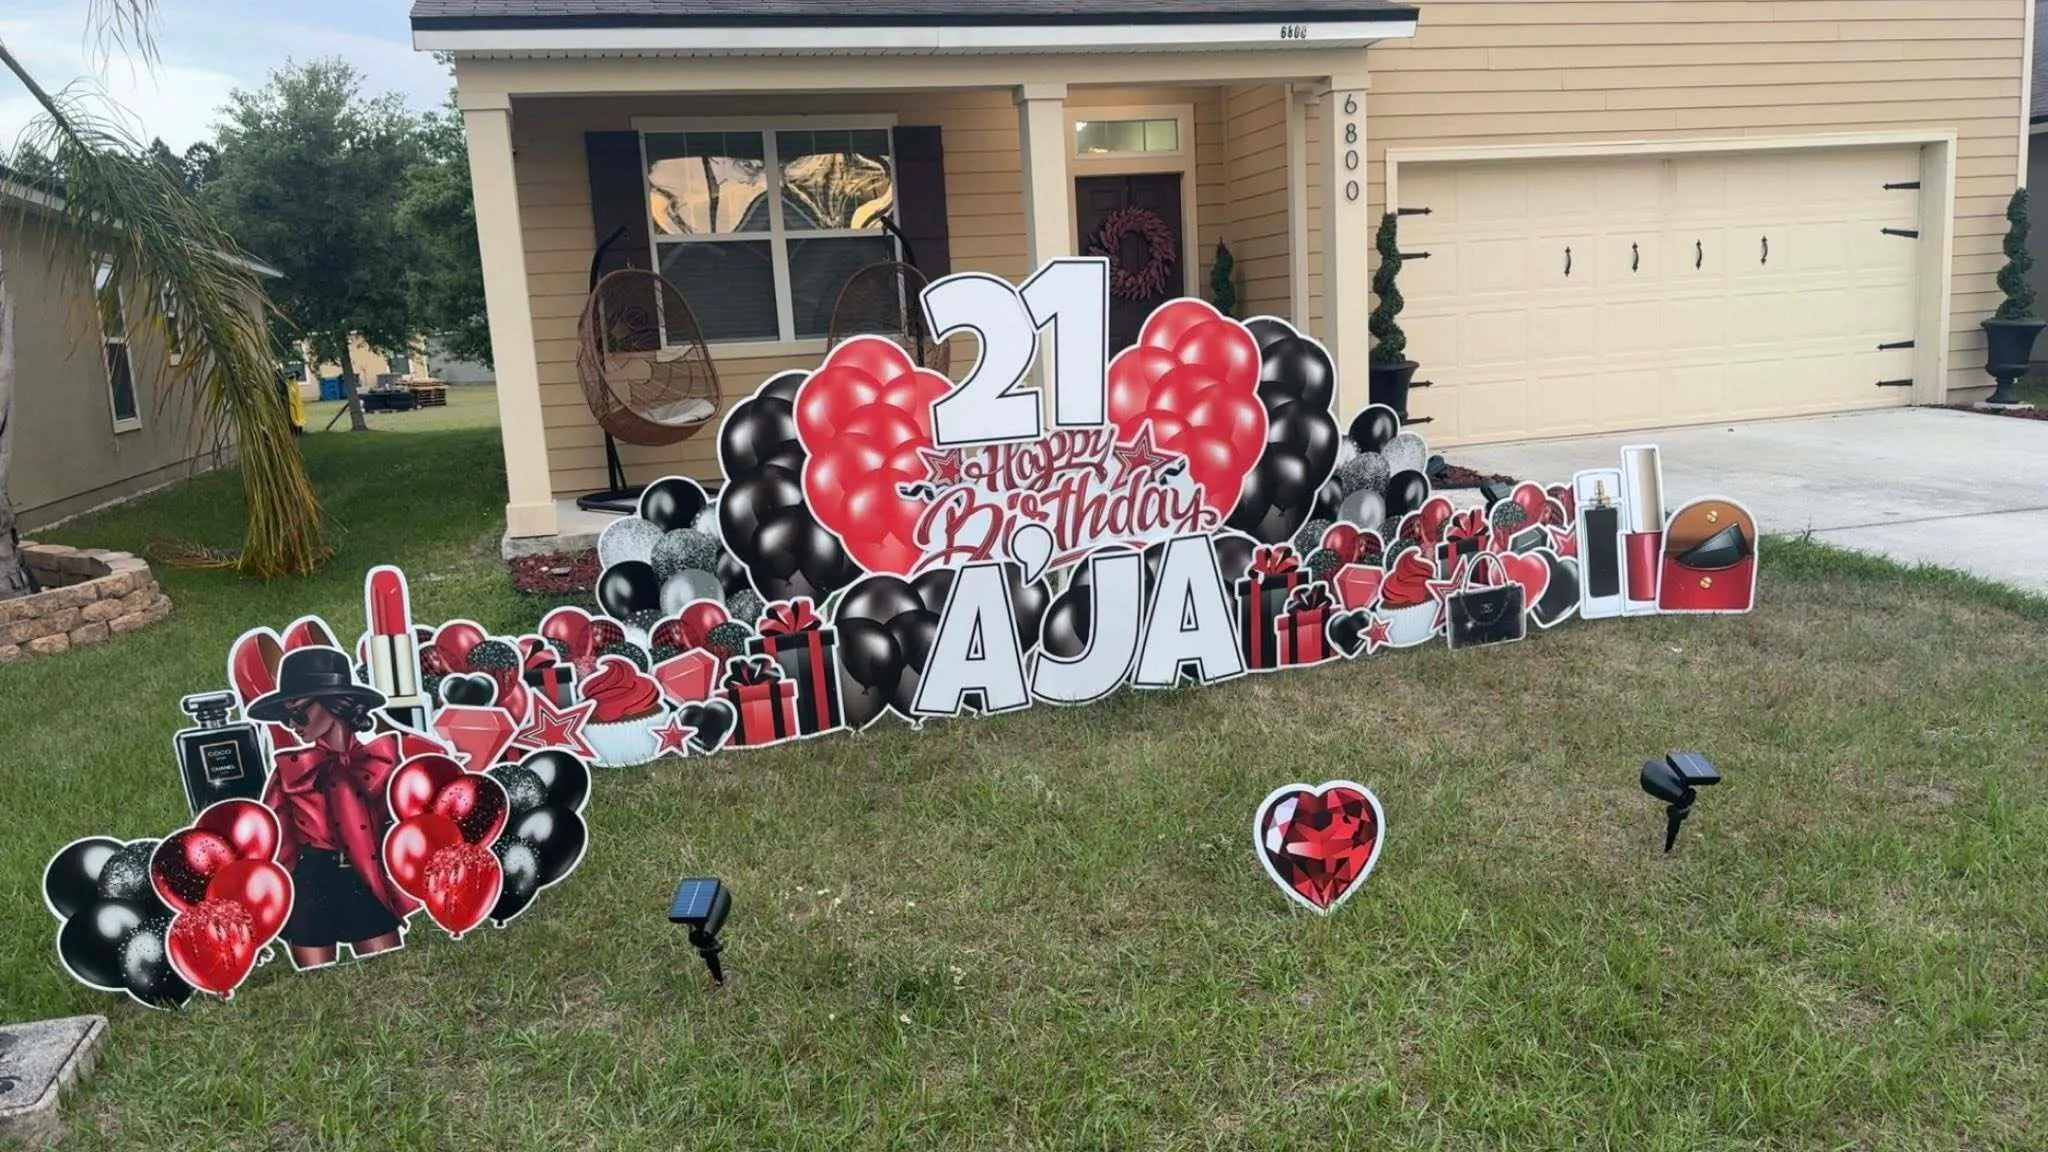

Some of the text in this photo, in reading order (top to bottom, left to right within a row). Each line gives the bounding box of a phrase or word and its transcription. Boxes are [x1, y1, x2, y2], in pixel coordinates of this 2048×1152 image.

[1344, 93, 1359, 201] 6800
[921, 257, 1109, 447] 21
[963, 427, 1116, 492] Happy
[912, 522, 1246, 716] A'JA
